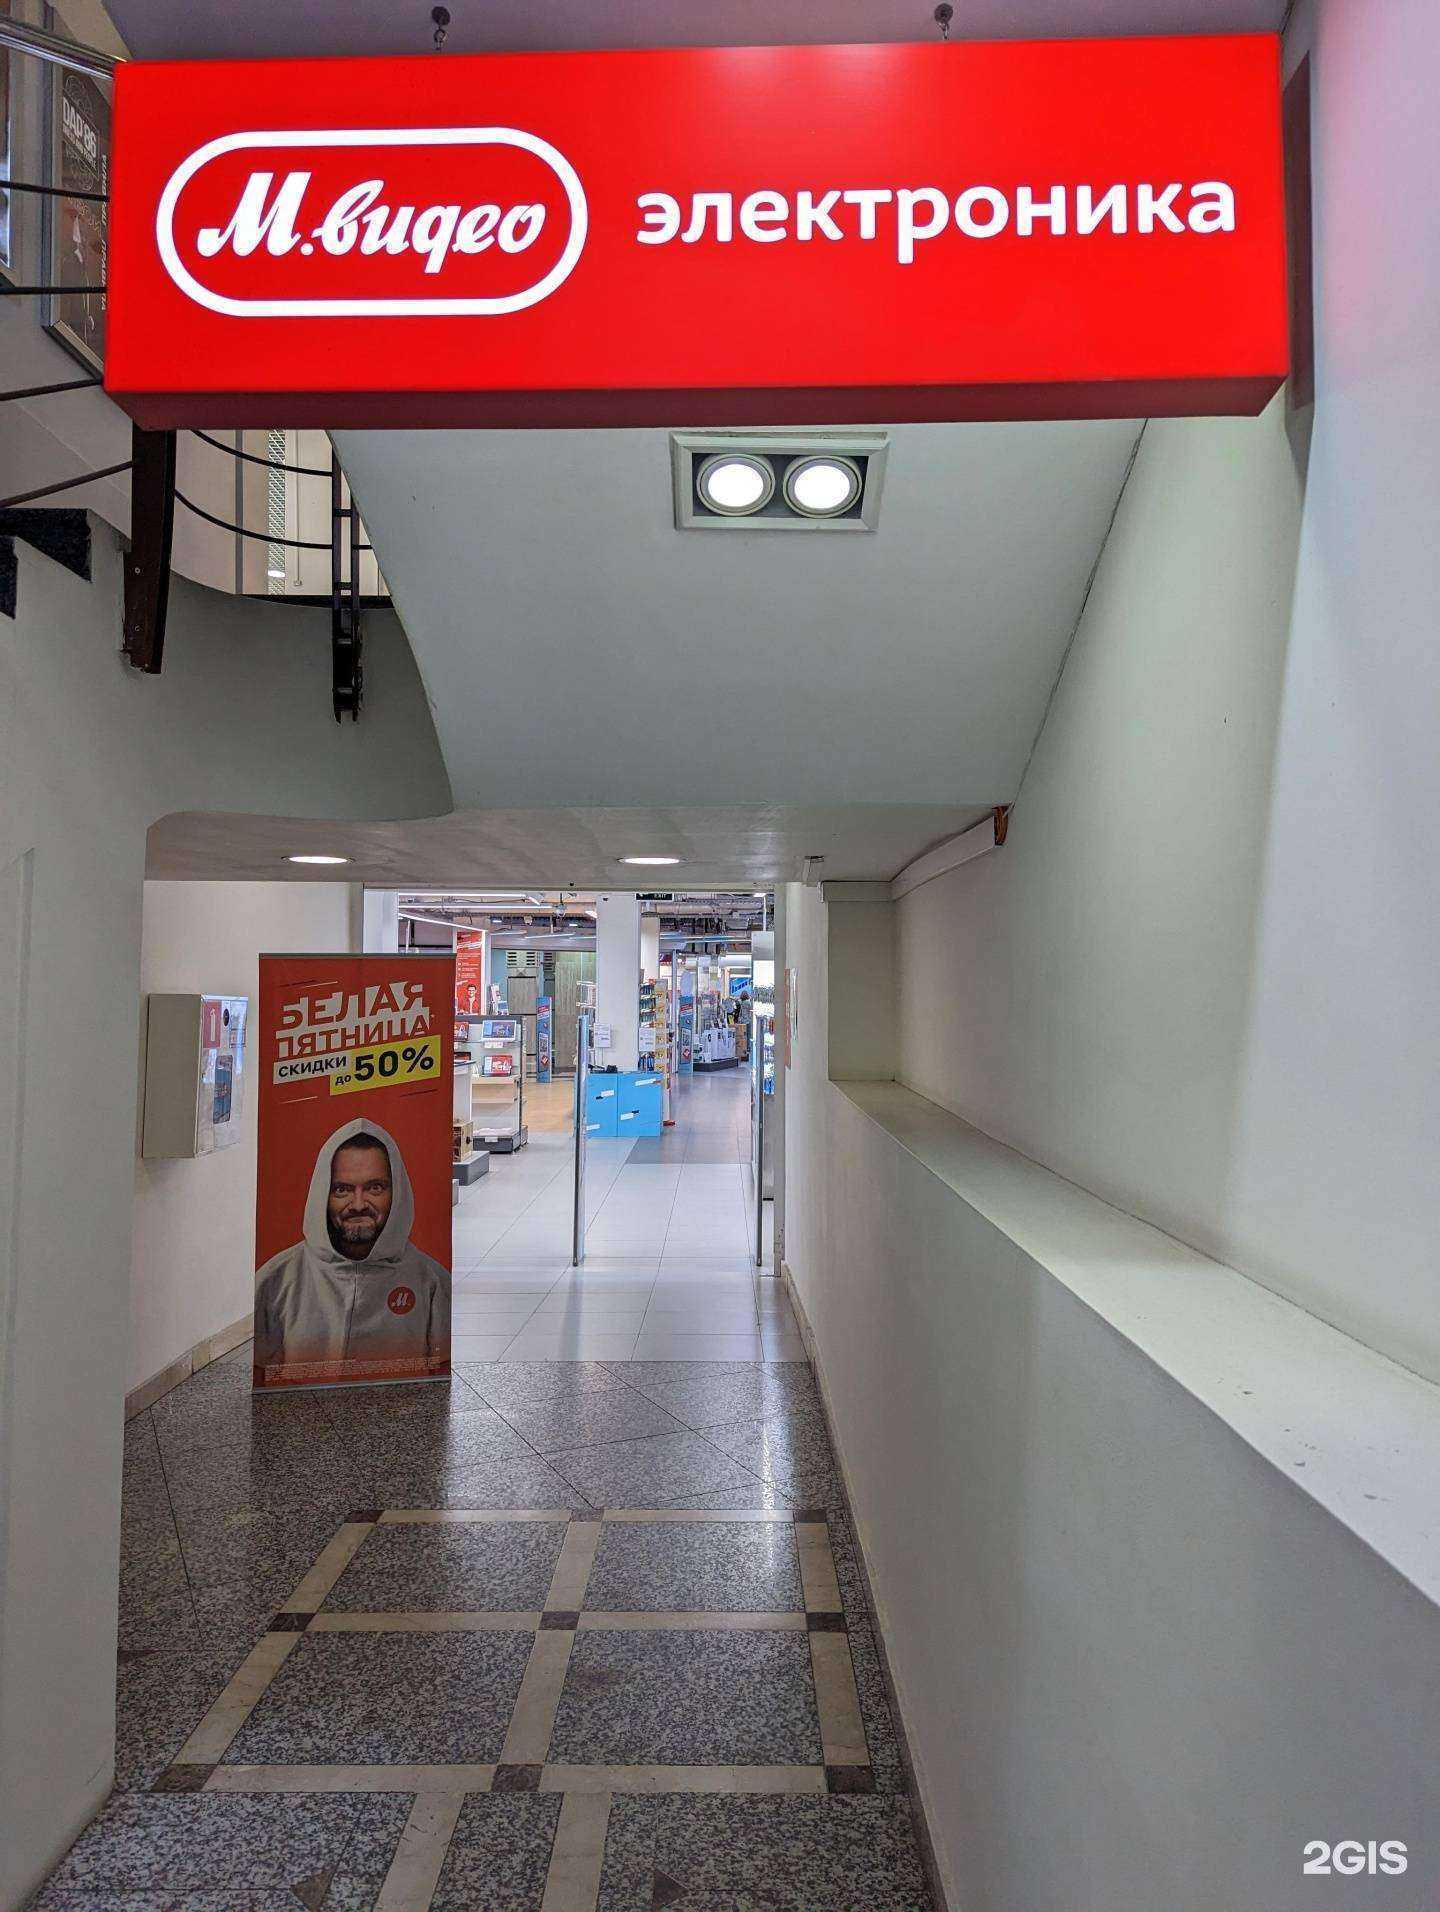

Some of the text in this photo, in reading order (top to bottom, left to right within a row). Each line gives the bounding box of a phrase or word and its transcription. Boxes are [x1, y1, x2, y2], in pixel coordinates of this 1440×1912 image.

[197, 171, 1236, 274] М.видео электроника
[279, 981, 424, 1031] БЕЛАЯ
[354, 1044, 434, 1082] 50%
